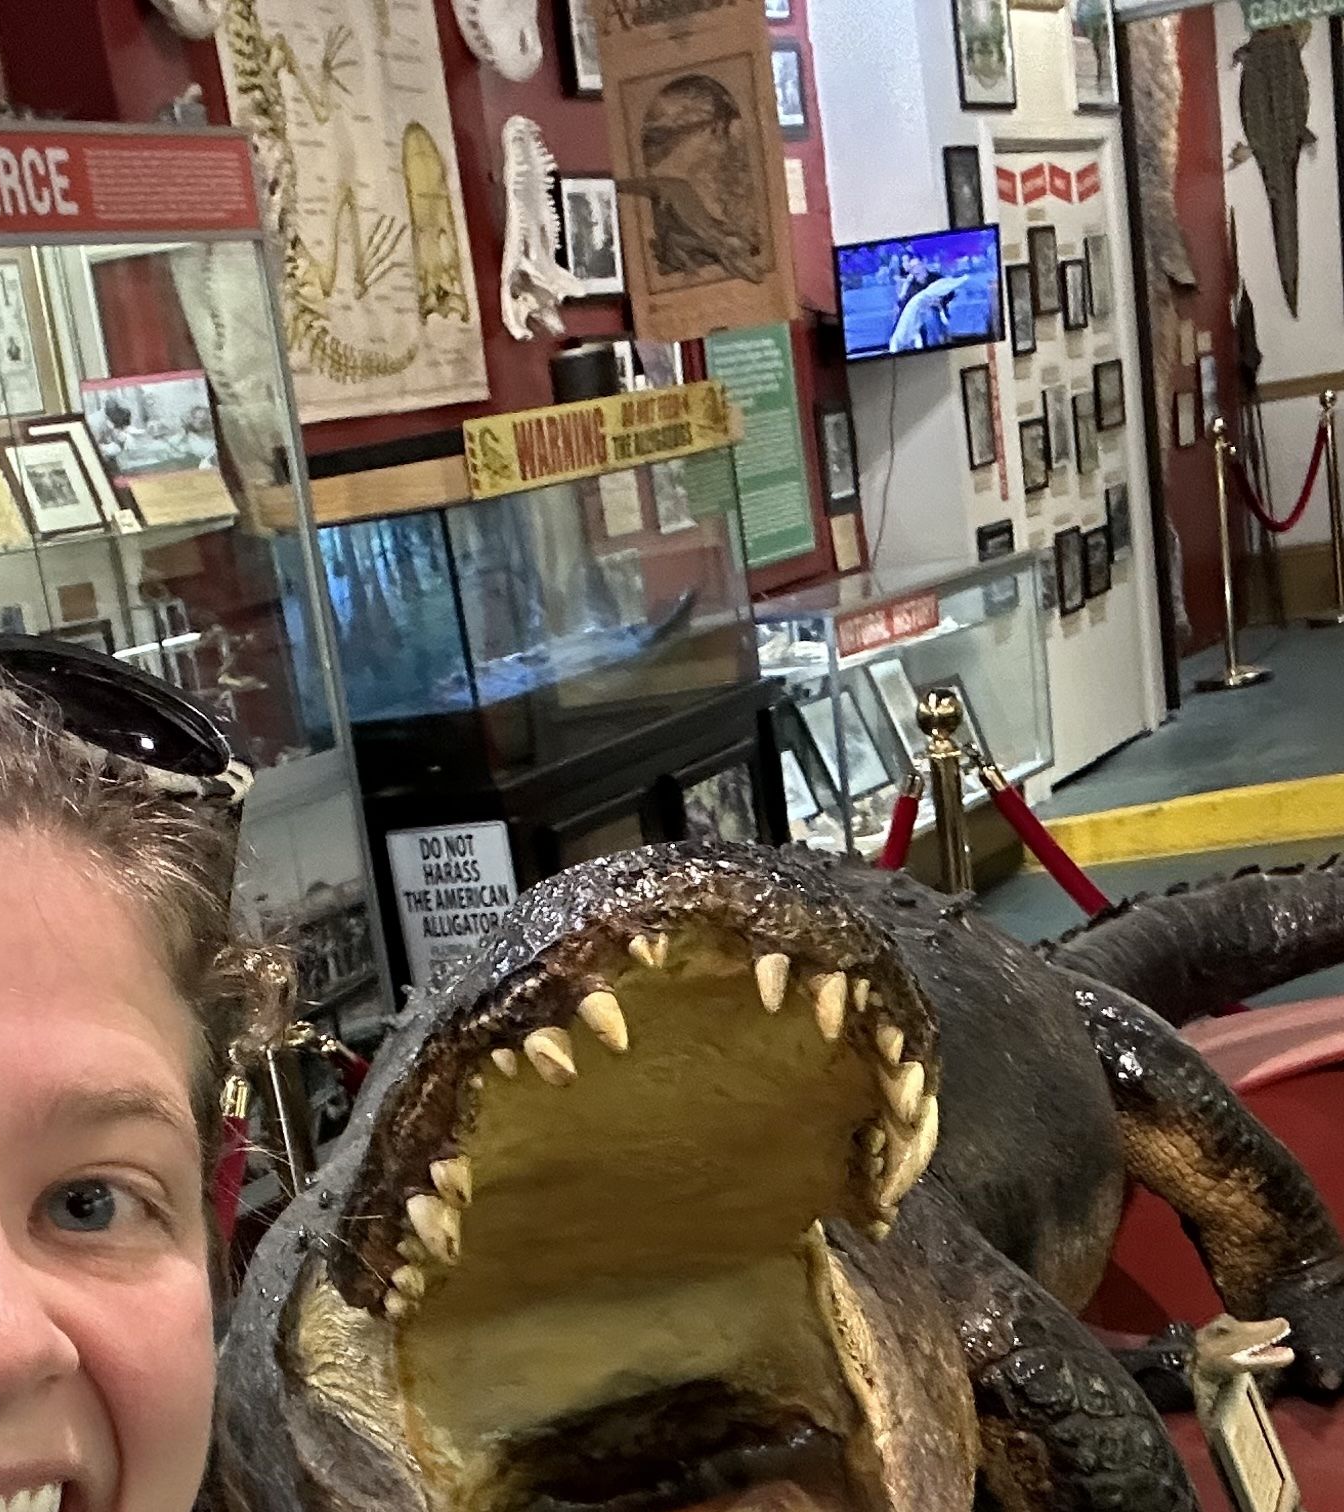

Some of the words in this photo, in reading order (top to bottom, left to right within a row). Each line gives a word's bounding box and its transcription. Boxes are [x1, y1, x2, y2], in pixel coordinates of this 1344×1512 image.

[513, 404, 607, 482] WARNING
[419, 836, 441, 860] DO
[444, 834, 474, 859] NOT
[422, 860, 480, 885] HARASS
[403, 890, 432, 913] THE
[436, 884, 510, 910] AMERICAN
